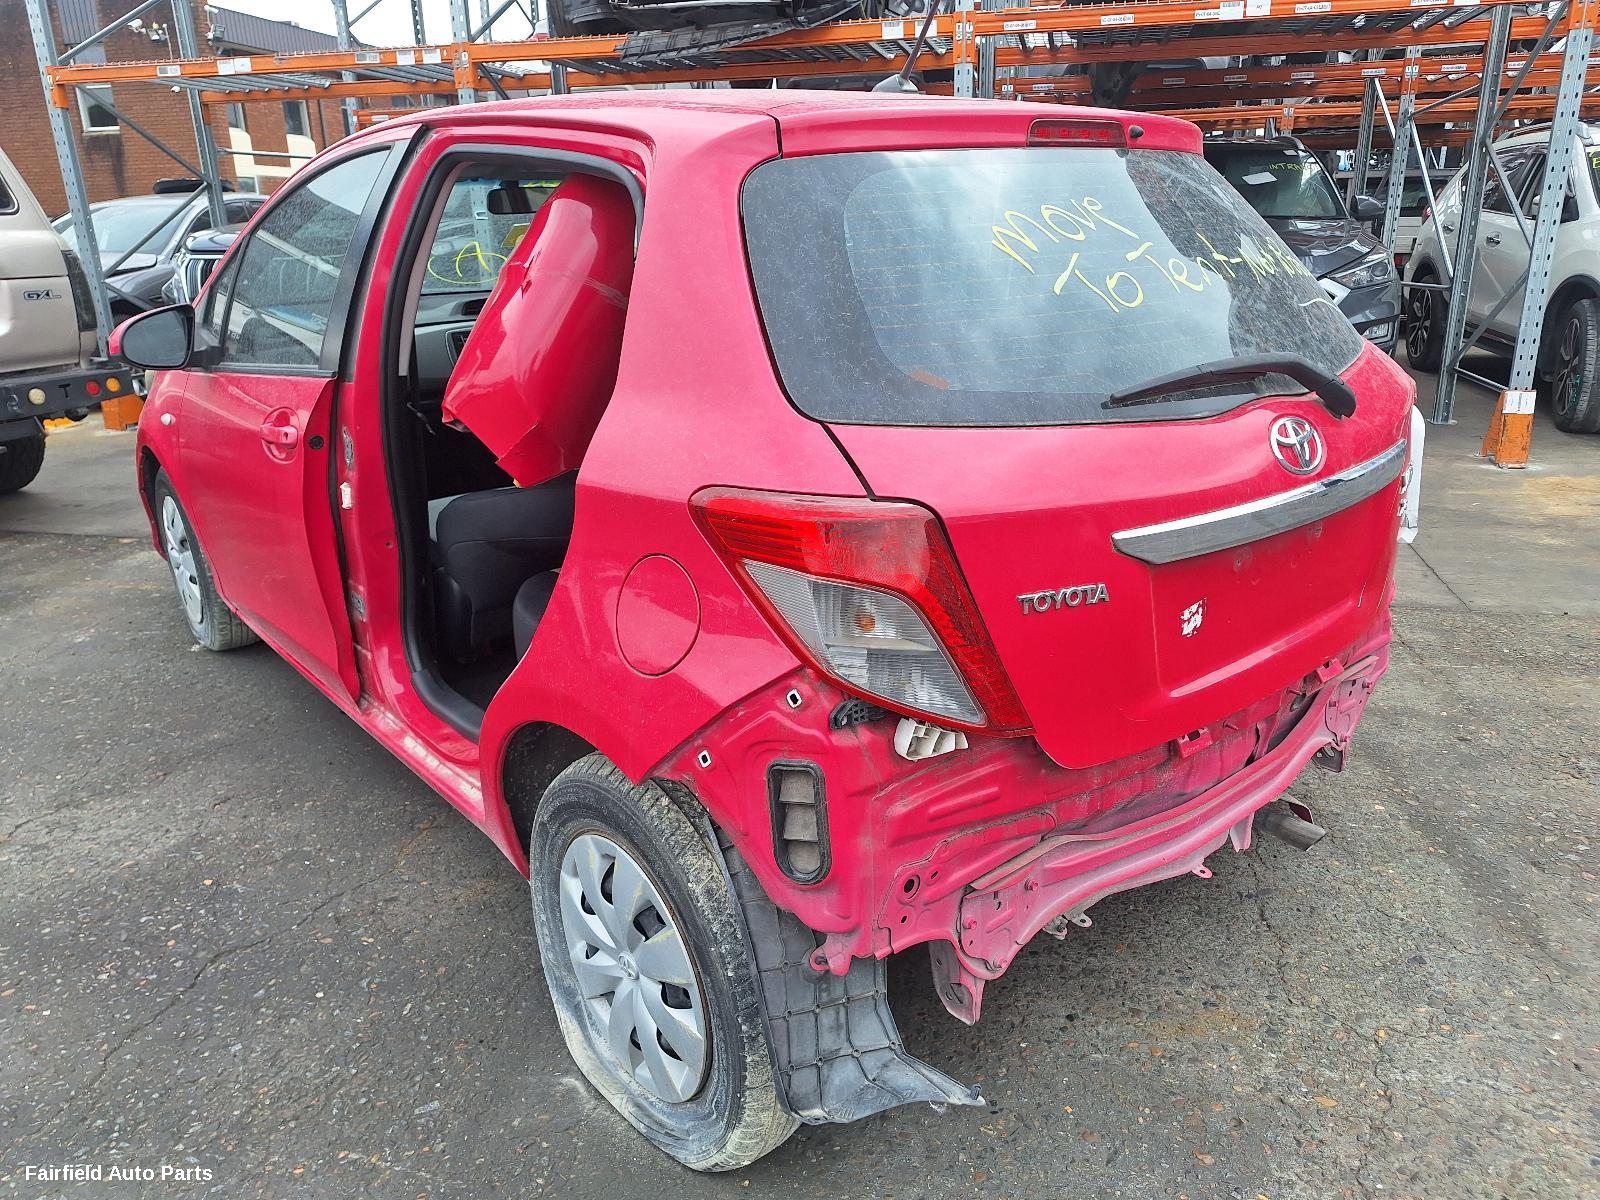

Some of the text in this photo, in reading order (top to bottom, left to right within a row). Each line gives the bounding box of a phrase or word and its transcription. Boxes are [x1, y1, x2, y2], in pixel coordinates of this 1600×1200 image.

[23, 289, 62, 301] GXL
[1053, 252, 1144, 313] To
[1016, 583, 1110, 616] TOYOTA
